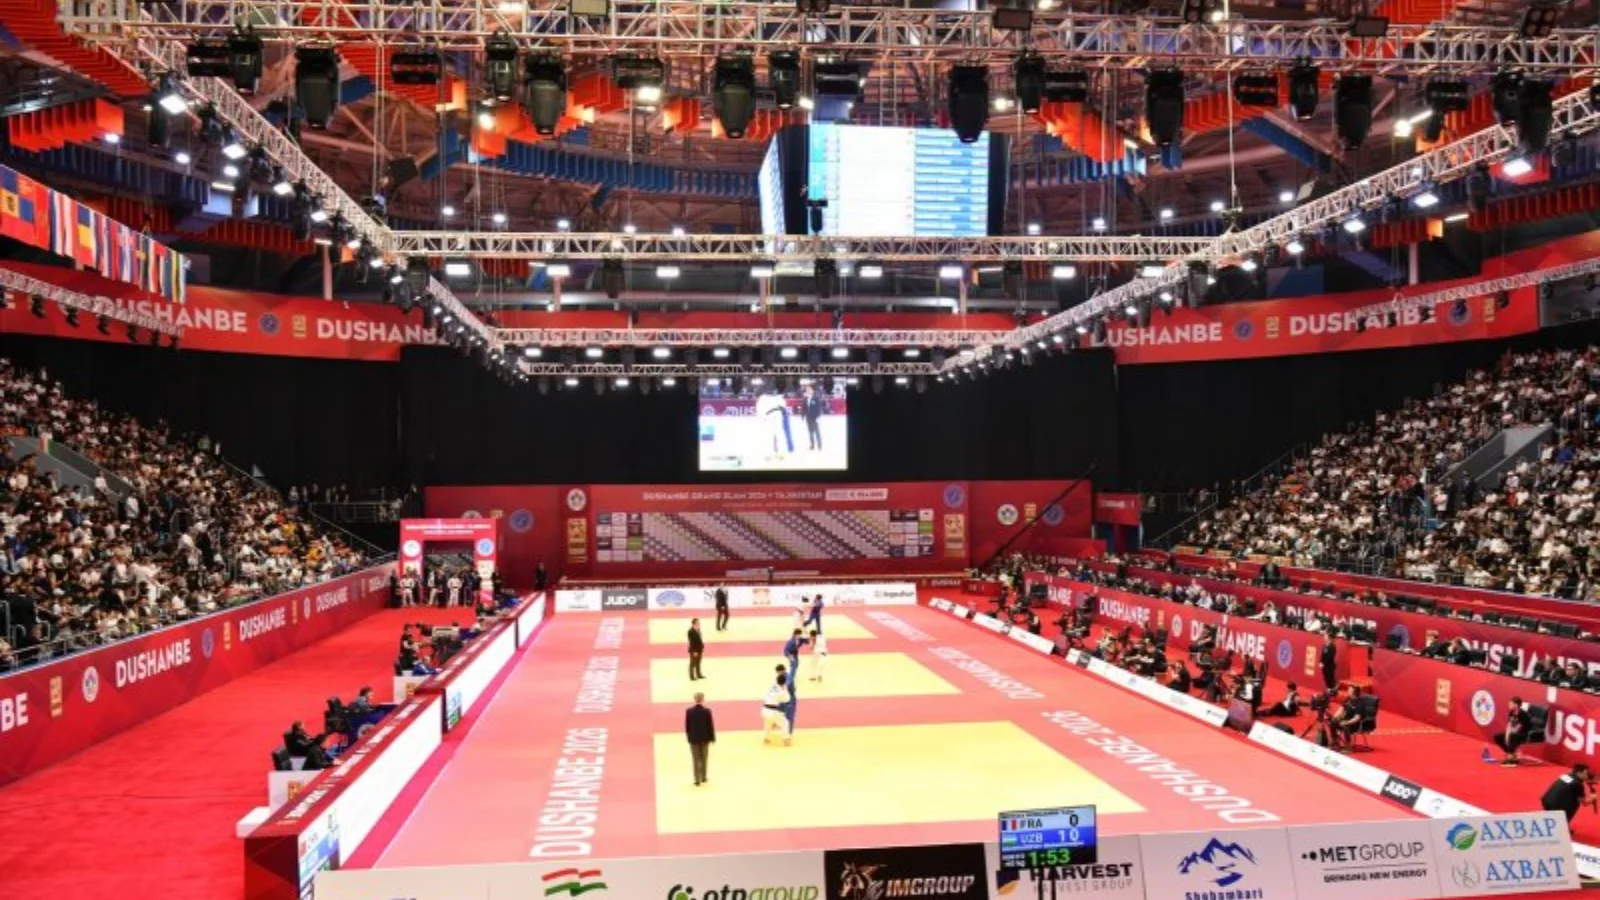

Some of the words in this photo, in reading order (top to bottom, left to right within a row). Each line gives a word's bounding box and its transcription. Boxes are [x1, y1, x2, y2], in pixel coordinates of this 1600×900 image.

[317, 317, 449, 346] DUSHANB
[604, 595, 637, 605] JUDO
[239, 607, 286, 641] DUSHANBE
[115, 638, 191, 687] DUSHANBE
[0, 693, 28, 732] BE
[562, 727, 609, 754] 2026
[1545, 709, 1600, 755] USH
[1085, 734, 1281, 823] DUSHANBE
[1385, 780, 1411, 799] JUDO
[528, 756, 605, 857] DUSHANBE
[1020, 818, 1043, 829] FRA
[1069, 814, 1079, 827] 0
[1020, 832, 1043, 843] UZB
[1029, 848, 1070, 866] 1:53
[1320, 842, 1425, 863] METGROUP
[1029, 862, 1133, 881] HARVEST
[1323, 875, 1367, 883] BRINGING
[1369, 872, 1390, 881] NEW
[1393, 869, 1427, 879] ENERGY
[885, 874, 975, 897] IMGROUP
[1033, 880, 1090, 893] HAVEST
